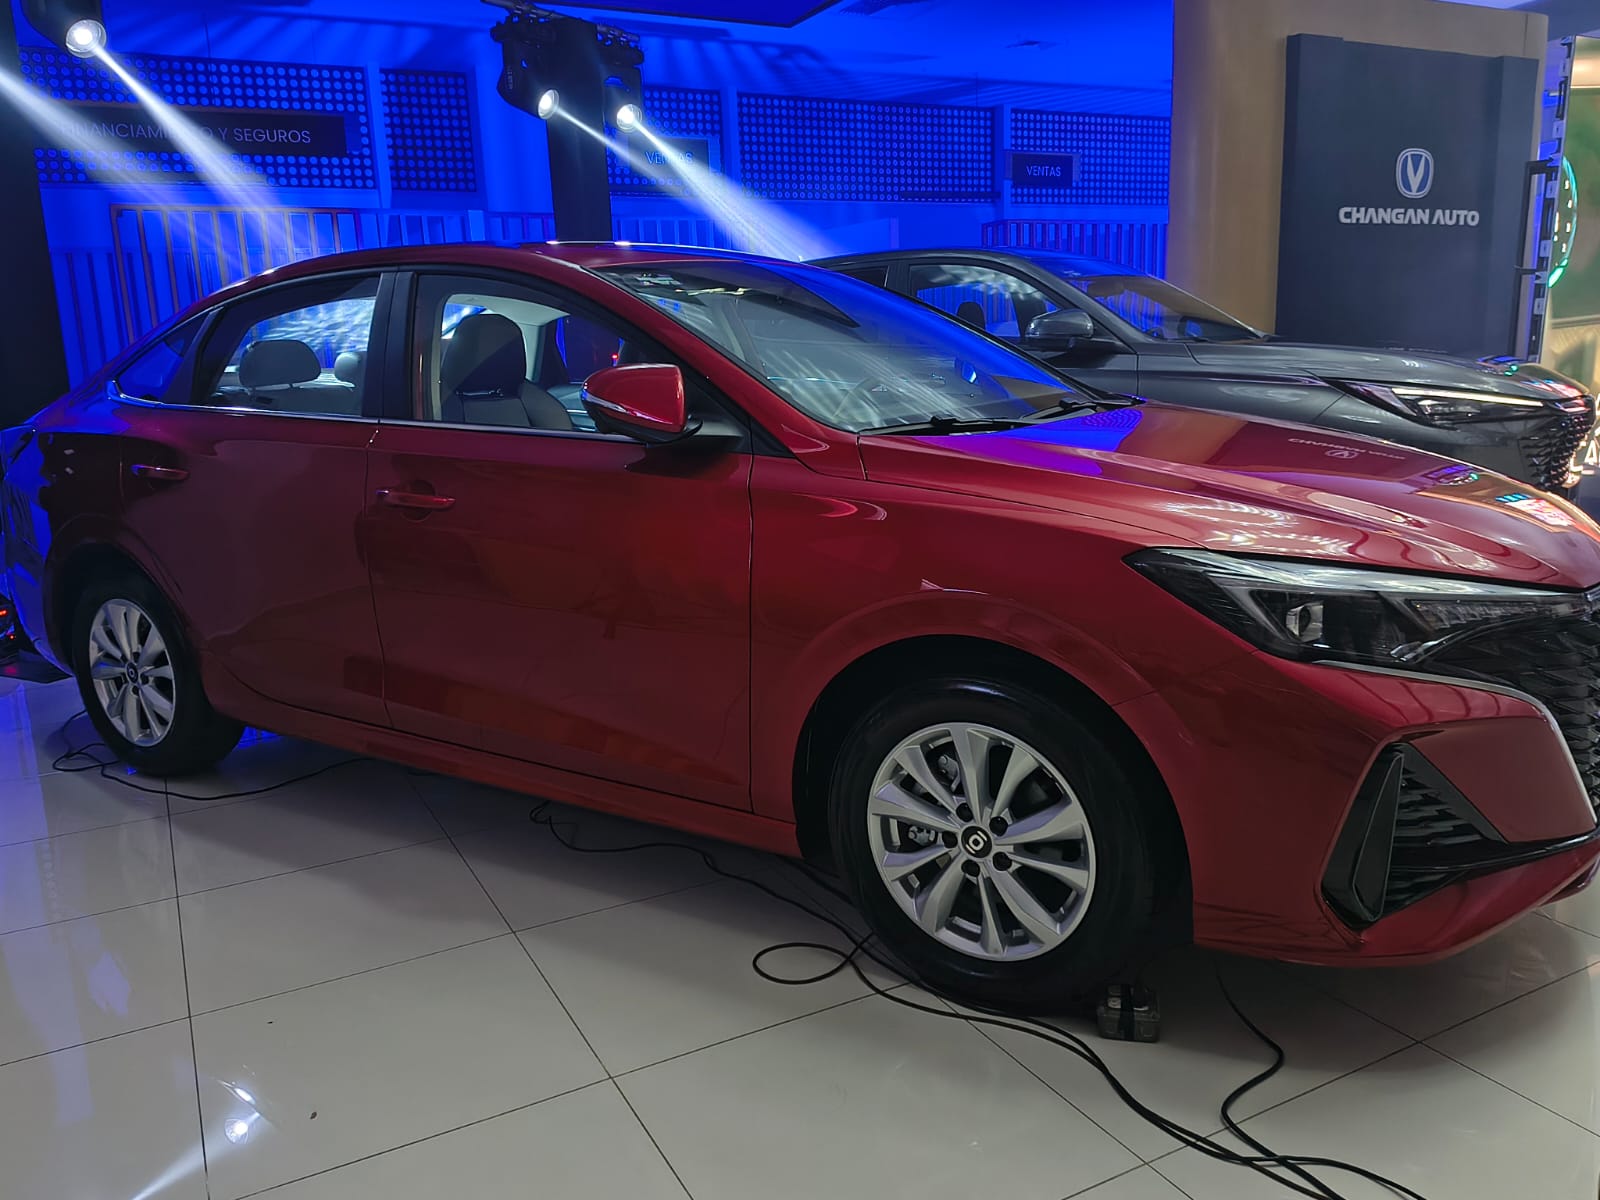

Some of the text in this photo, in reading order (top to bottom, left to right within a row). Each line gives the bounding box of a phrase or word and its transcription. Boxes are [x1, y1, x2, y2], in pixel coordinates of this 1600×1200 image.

[218, 127, 228, 141] Y
[233, 127, 311, 144] SEGUROS
[645, 151, 693, 165] VEAS
[1026, 165, 1061, 177] VENTAS
[1338, 206, 1480, 227] CHANGAN AUTO
